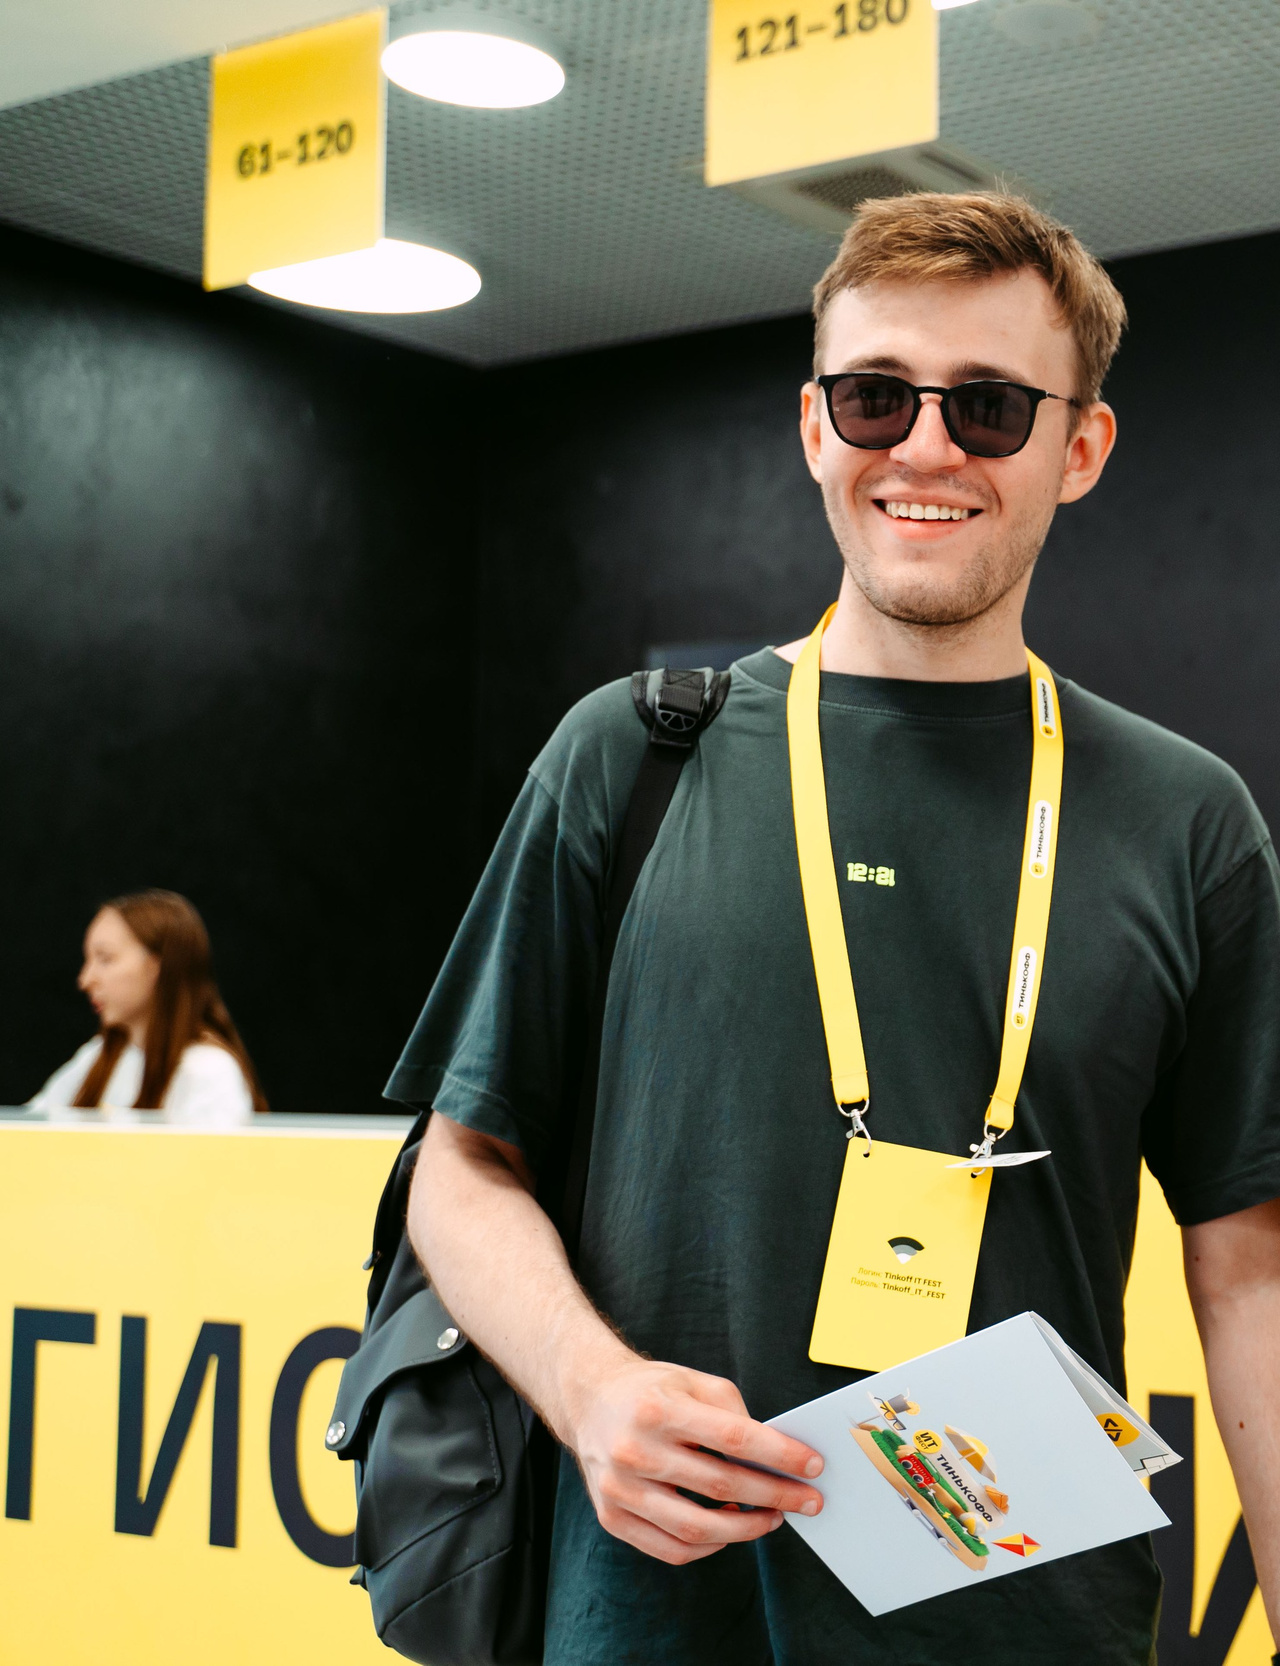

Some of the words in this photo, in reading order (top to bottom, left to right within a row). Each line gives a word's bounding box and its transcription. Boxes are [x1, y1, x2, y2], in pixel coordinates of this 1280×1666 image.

[735, 0, 909, 62] 121-180
[237, 120, 354, 178] 61-120
[1018, 952, 1031, 1009] ТИНЬКОФФ
[882, 1282, 946, 1300] Tinkoff_IT_FEST
[884, 1272, 913, 1283] Tinkoff
[914, 1277, 922, 1285] IT
[923, 1278, 942, 1288] FEST
[919, 1432, 938, 1448] ИТ
[936, 1453, 993, 1522] ТИНЬКОФФ
